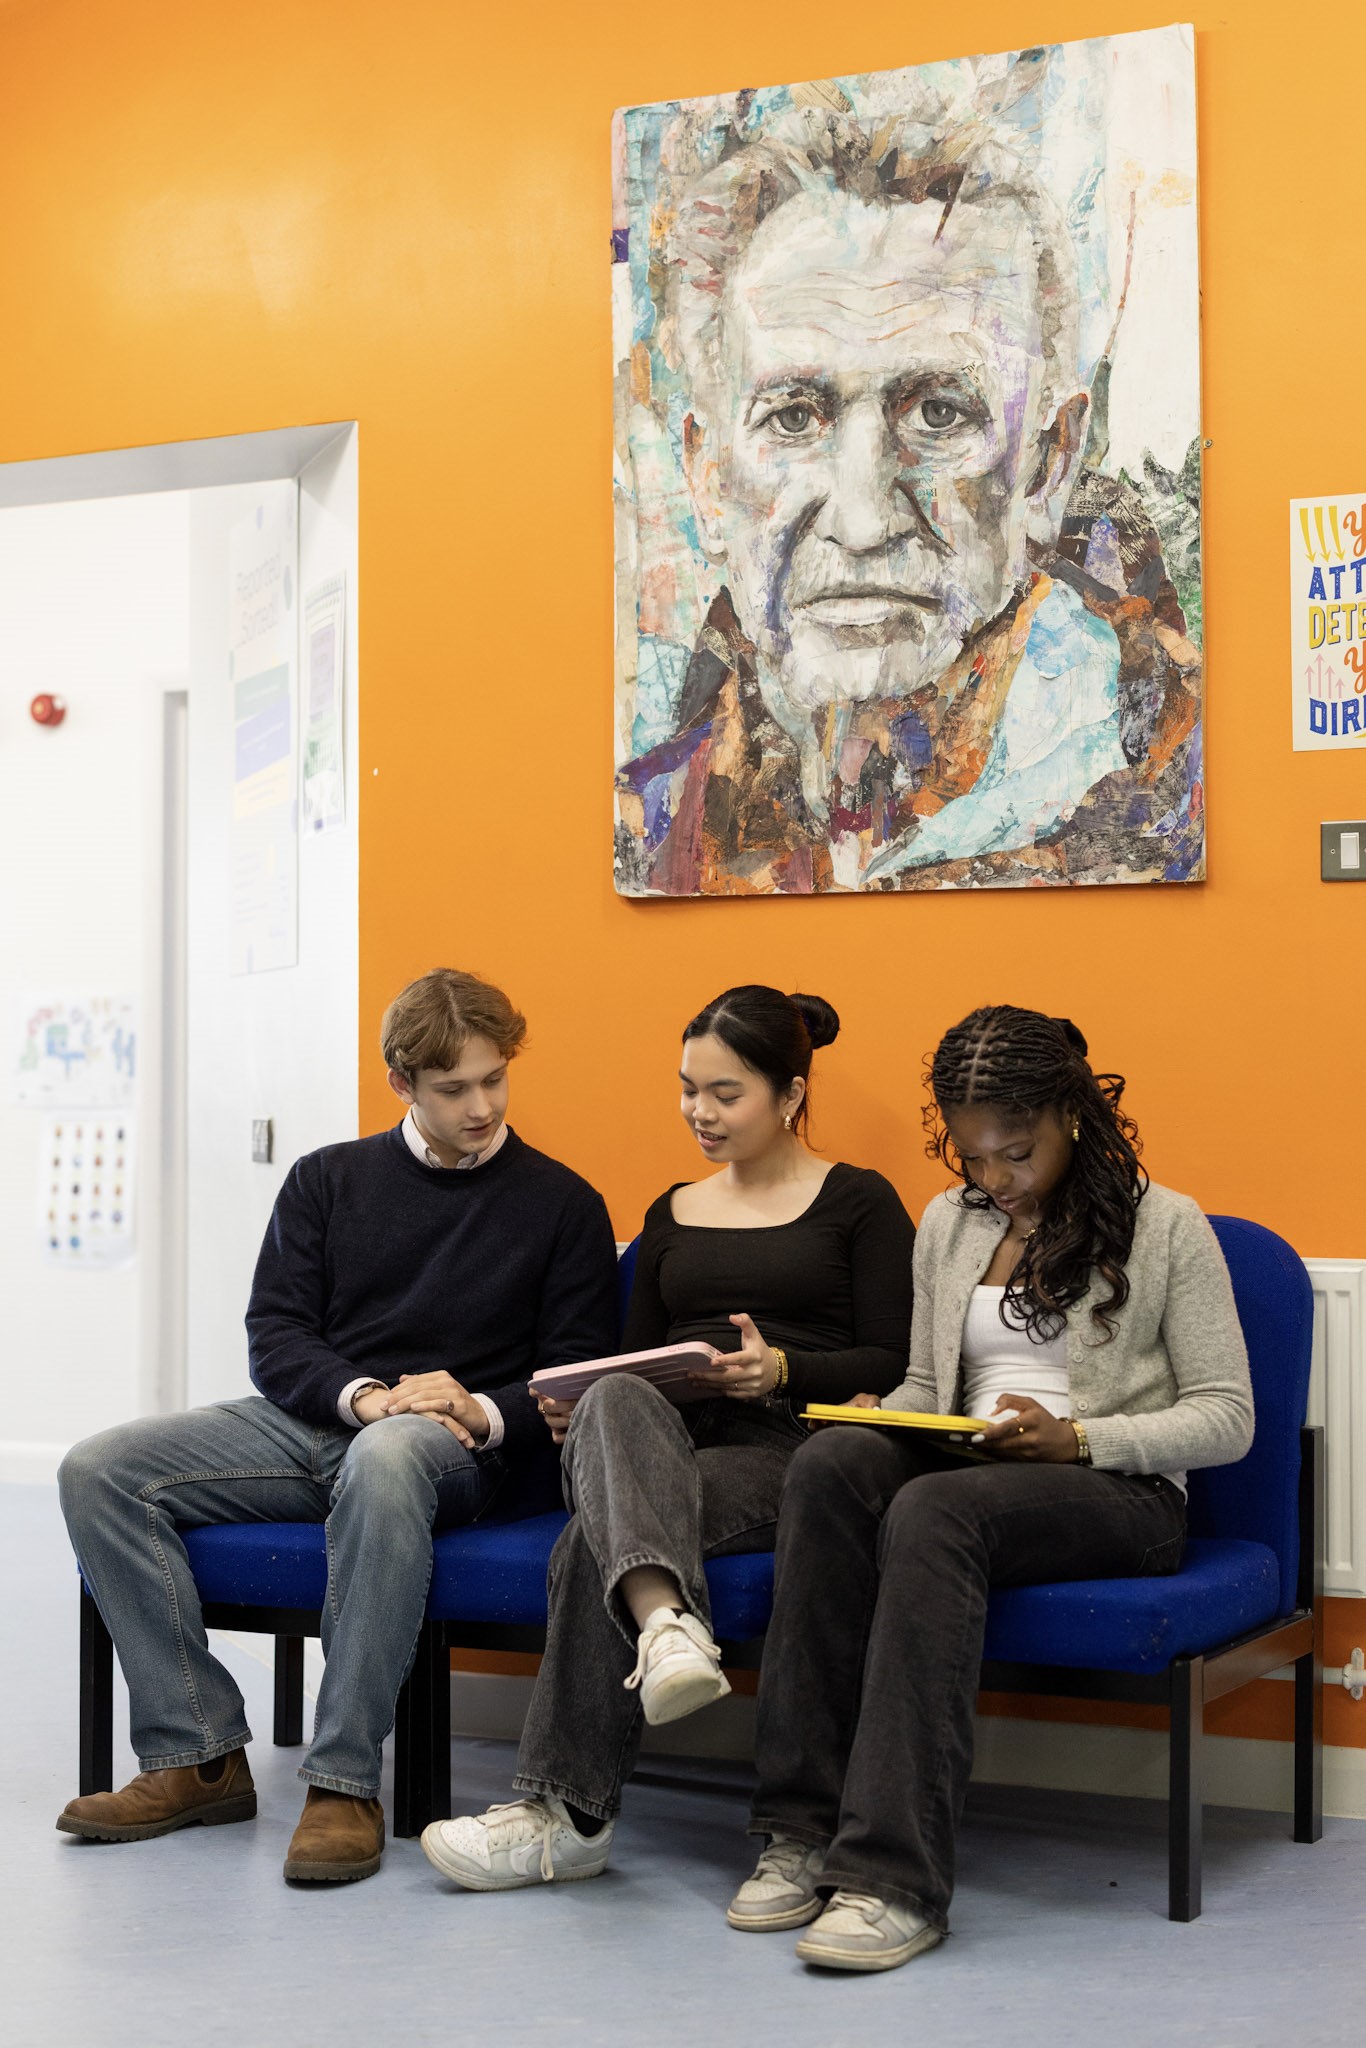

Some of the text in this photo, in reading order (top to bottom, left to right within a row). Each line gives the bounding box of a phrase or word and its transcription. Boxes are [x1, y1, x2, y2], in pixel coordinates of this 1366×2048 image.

[1308, 557, 1366, 600] ATT
[1309, 602, 1366, 649] DETE
[1309, 694, 1366, 735] DIR
